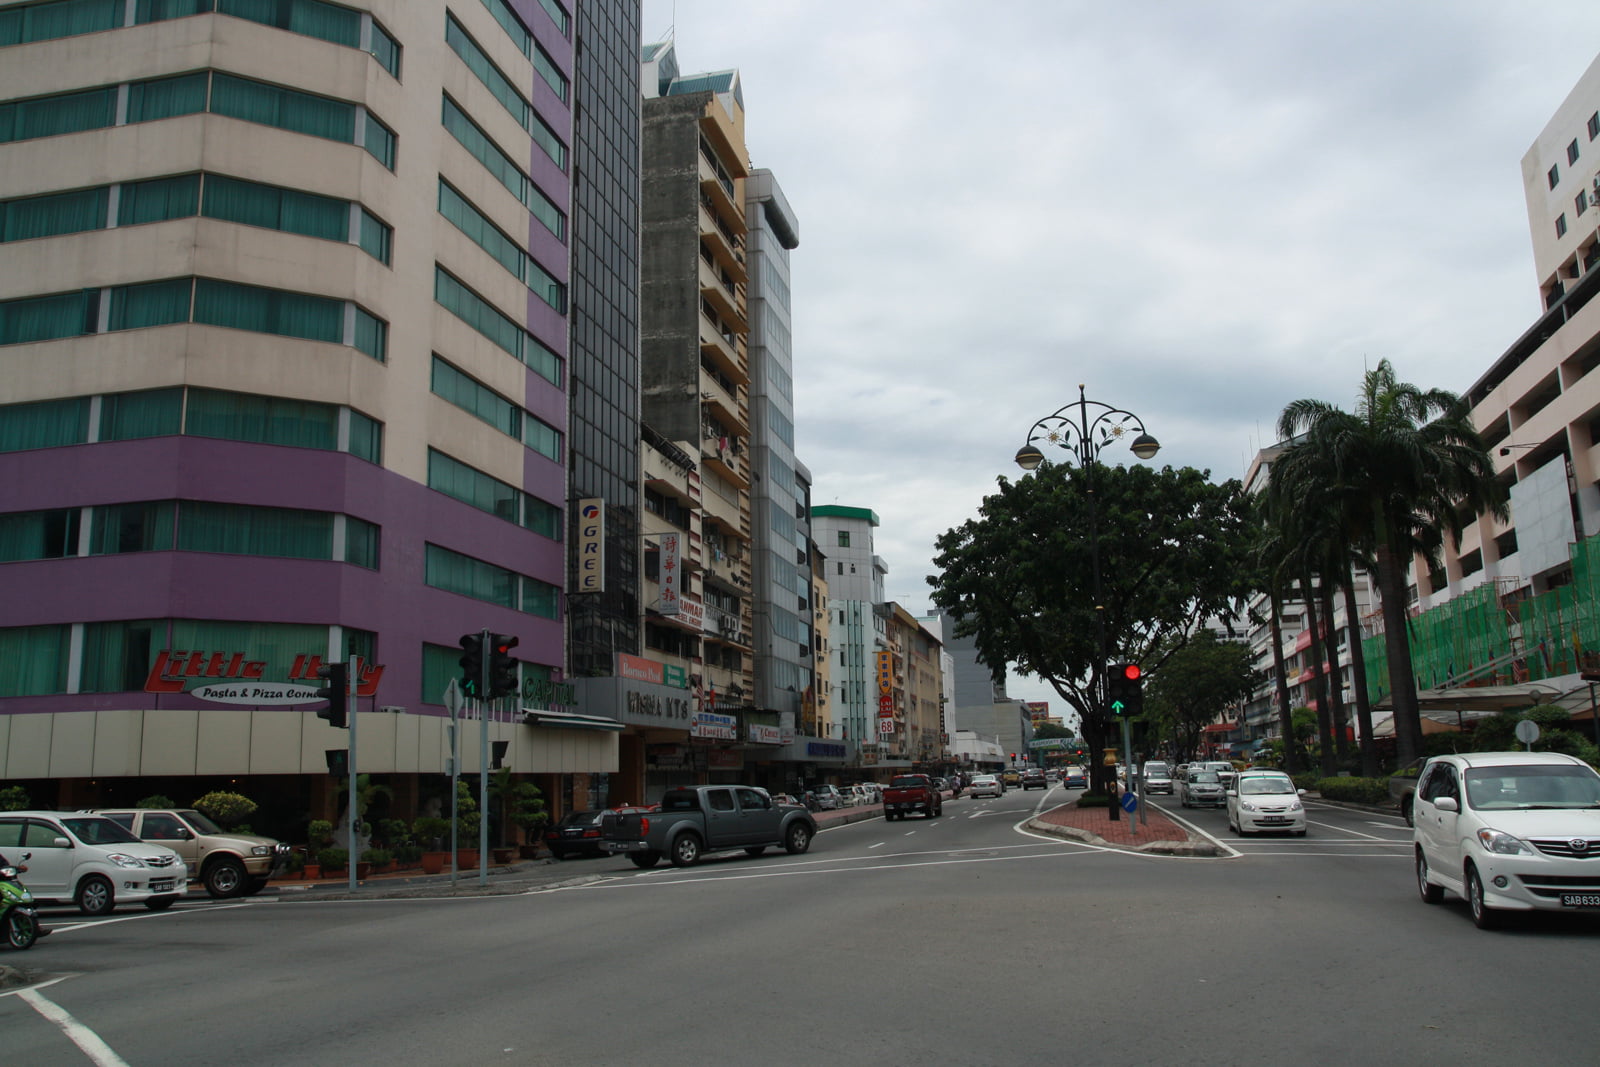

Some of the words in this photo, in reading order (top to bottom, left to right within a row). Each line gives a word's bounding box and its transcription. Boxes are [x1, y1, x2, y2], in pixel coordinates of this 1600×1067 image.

[583, 525, 598, 587] GREE
[144, 650, 267, 693] Little
[623, 662, 648, 679] Borneo
[203, 688, 237, 698] Pasta
[241, 689, 248, 698] &
[252, 688, 283, 699] Pizza
[521, 677, 578, 706] CAPITAL
[627, 690, 662, 716] WISMA
[665, 696, 688, 720] KTS
[881, 721, 892, 732] 68
